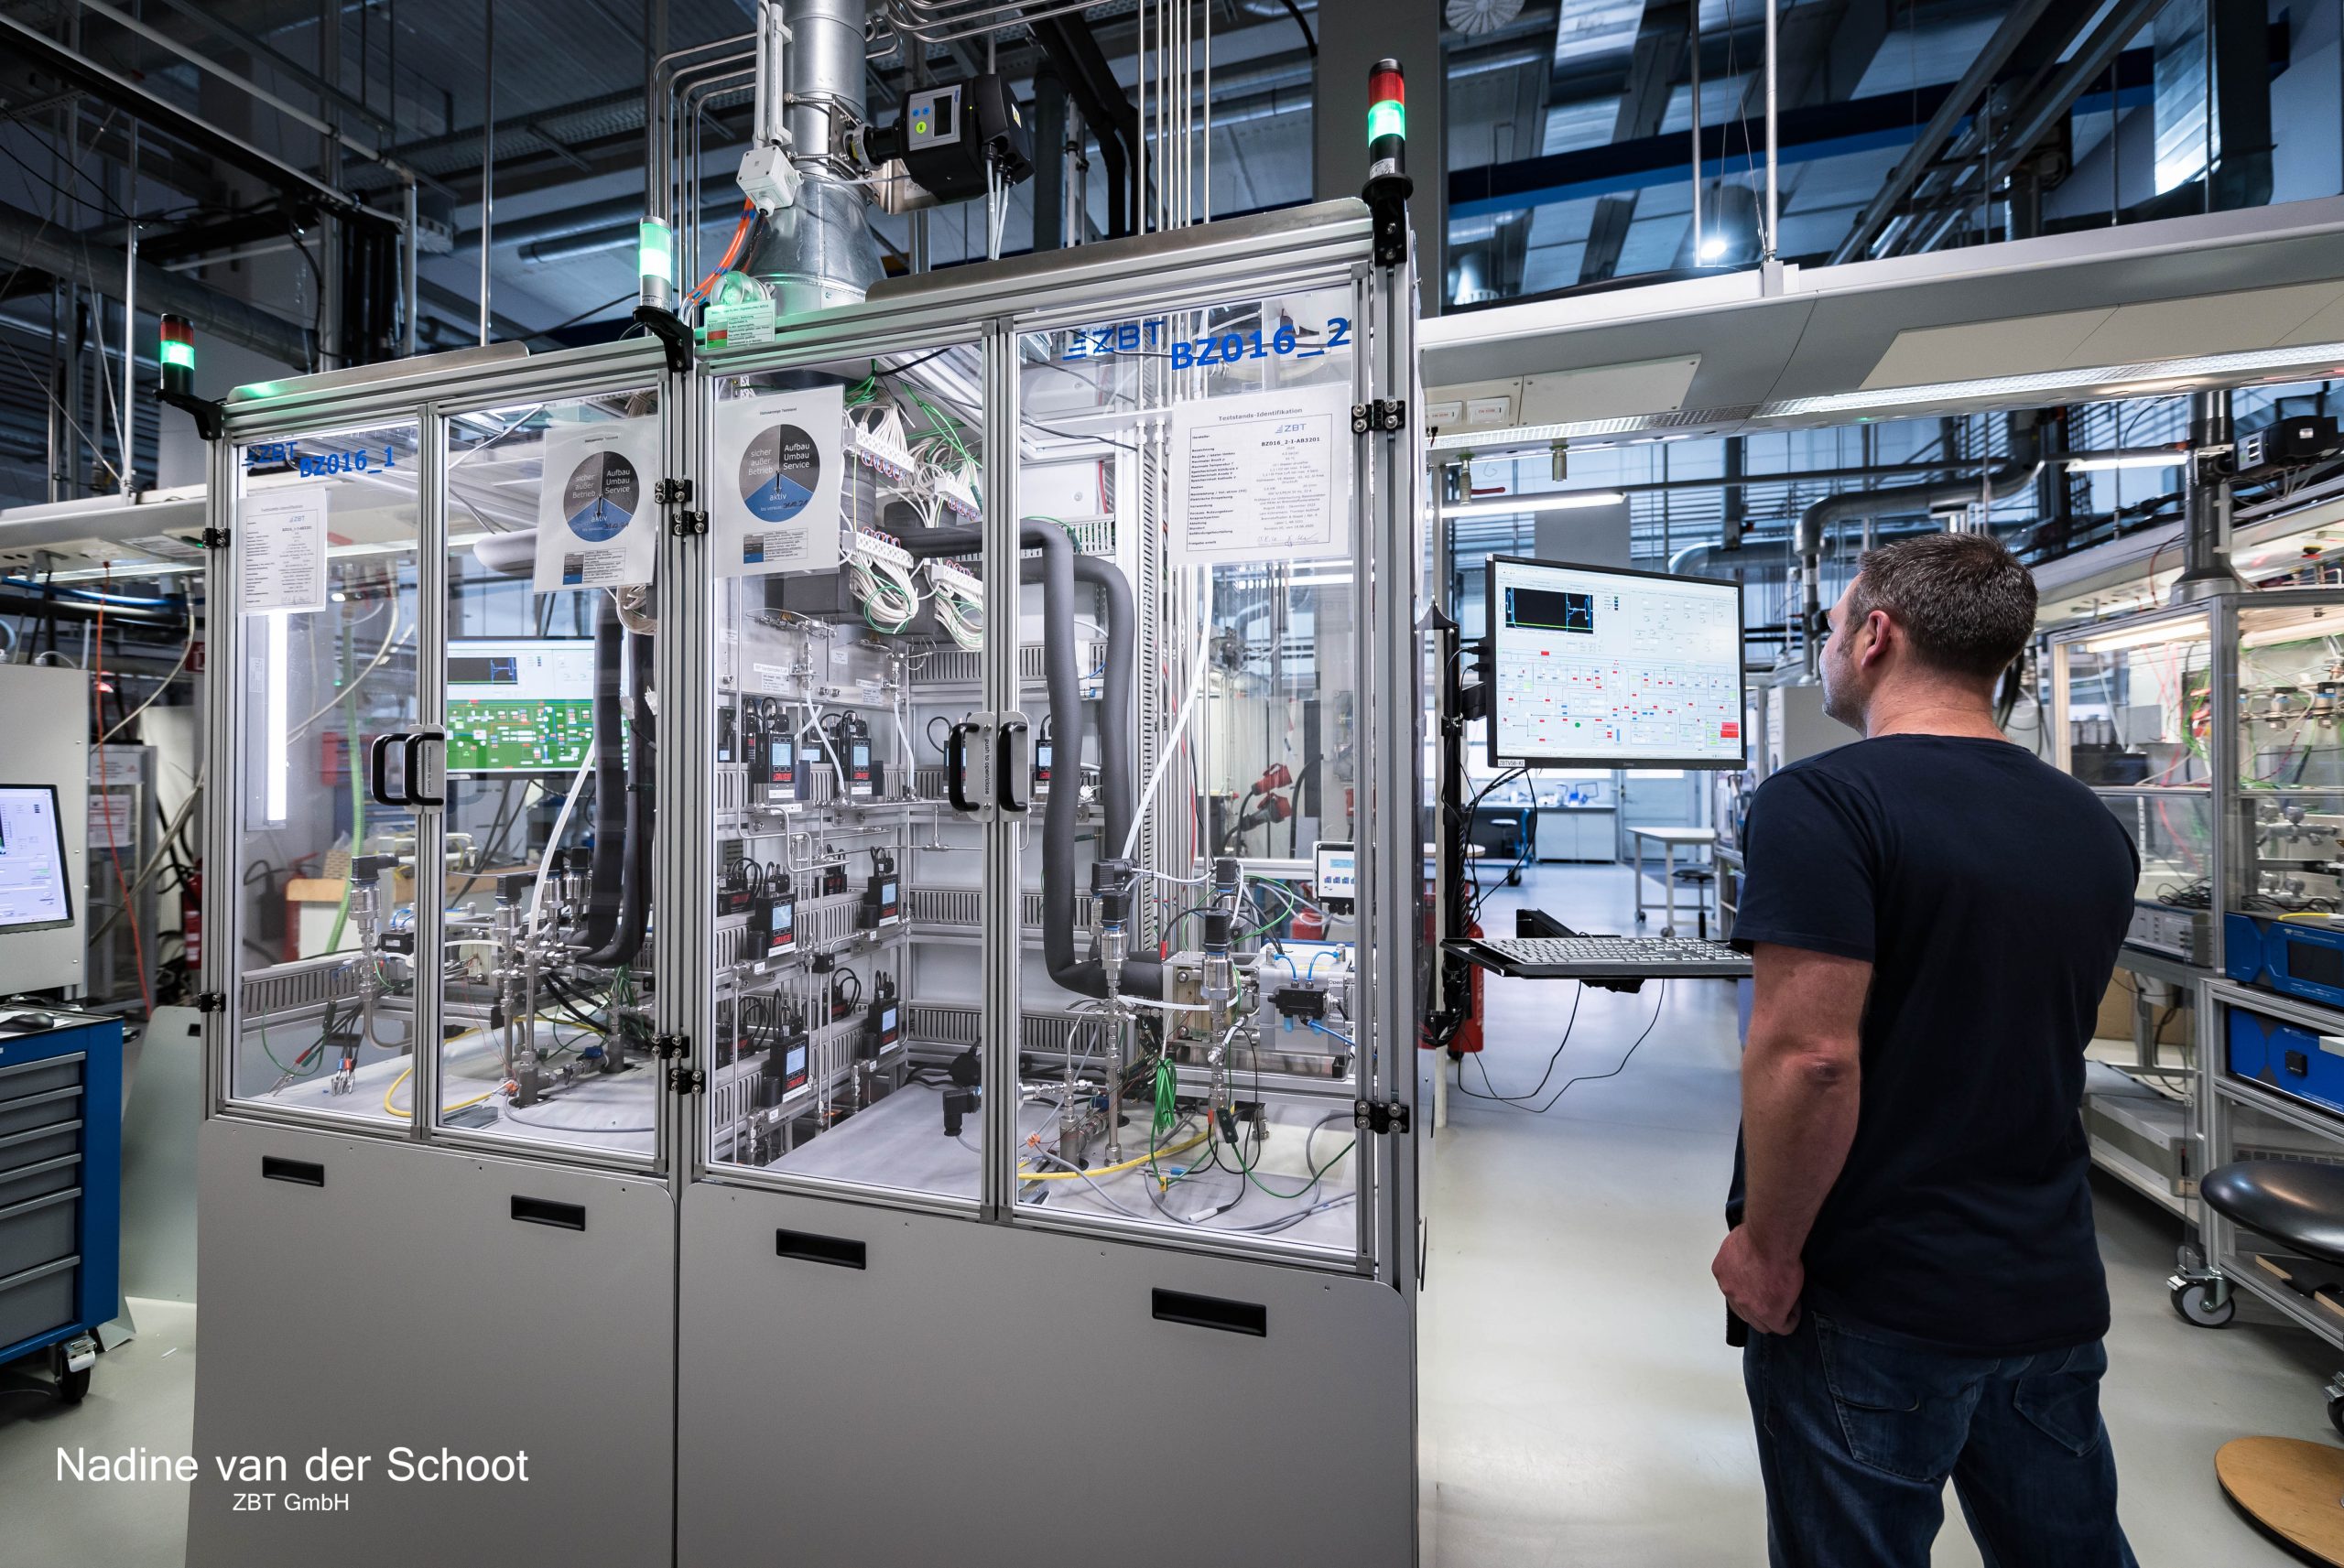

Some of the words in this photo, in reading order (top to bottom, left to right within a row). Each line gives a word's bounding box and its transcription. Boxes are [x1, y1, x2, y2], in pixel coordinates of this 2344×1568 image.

[1171, 317, 1351, 371] BZ016_2
[1218, 407, 1303, 422] Teststands-Identifikation
[784, 443, 810, 452] Aufbau
[750, 449, 772, 458] sicher
[783, 451, 809, 461] Umbau
[299, 445, 396, 479] BZ016_1
[750, 458, 771, 467] außer
[783, 460, 810, 470] Service
[606, 469, 631, 477] Aufbau
[748, 466, 774, 476] Betrieb
[575, 473, 595, 482] sicher
[605, 477, 630, 485] Umbau
[574, 481, 594, 491] außer
[605, 485, 631, 494] Service
[572, 491, 596, 500] Betrieb
[769, 492, 787, 502] aktiv
[591, 514, 609, 523] aktiv
